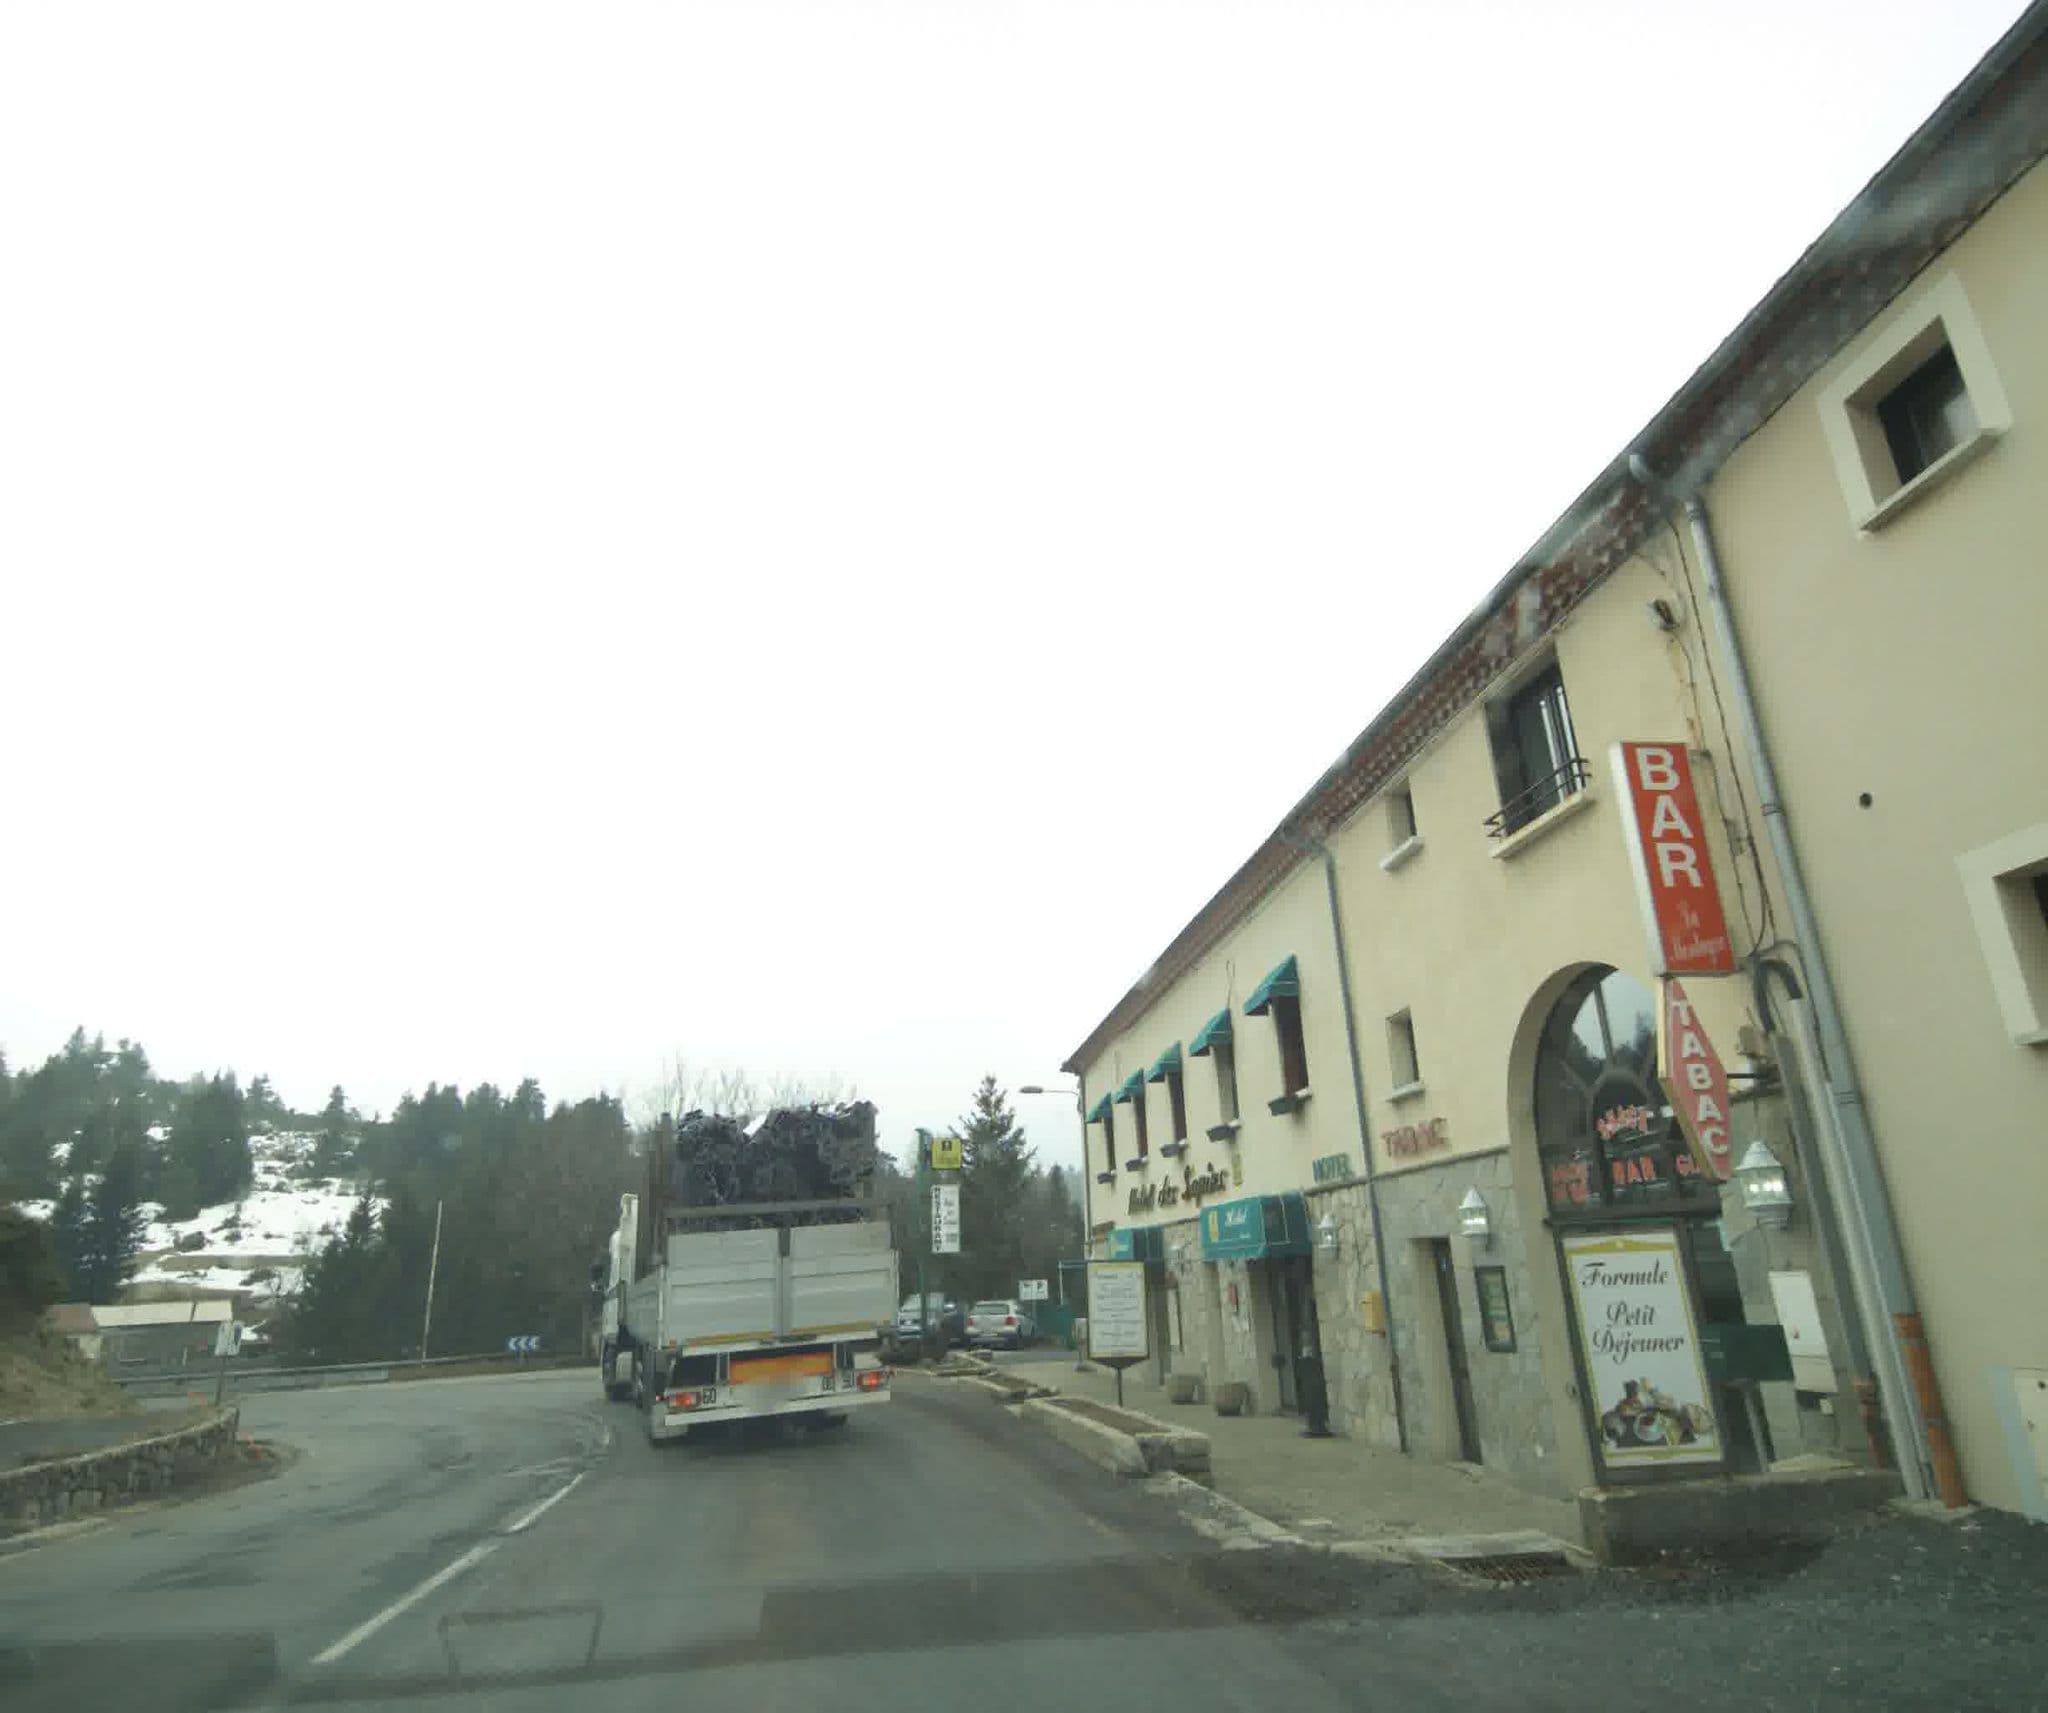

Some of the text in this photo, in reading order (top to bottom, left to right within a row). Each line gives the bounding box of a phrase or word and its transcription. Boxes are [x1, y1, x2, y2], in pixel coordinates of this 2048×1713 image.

[1636, 746, 1703, 889] BAR
[1672, 1000, 1730, 1156] TABAC
[1580, 1258, 1669, 1287] Formule
[1606, 1300, 1657, 1326] Petit
